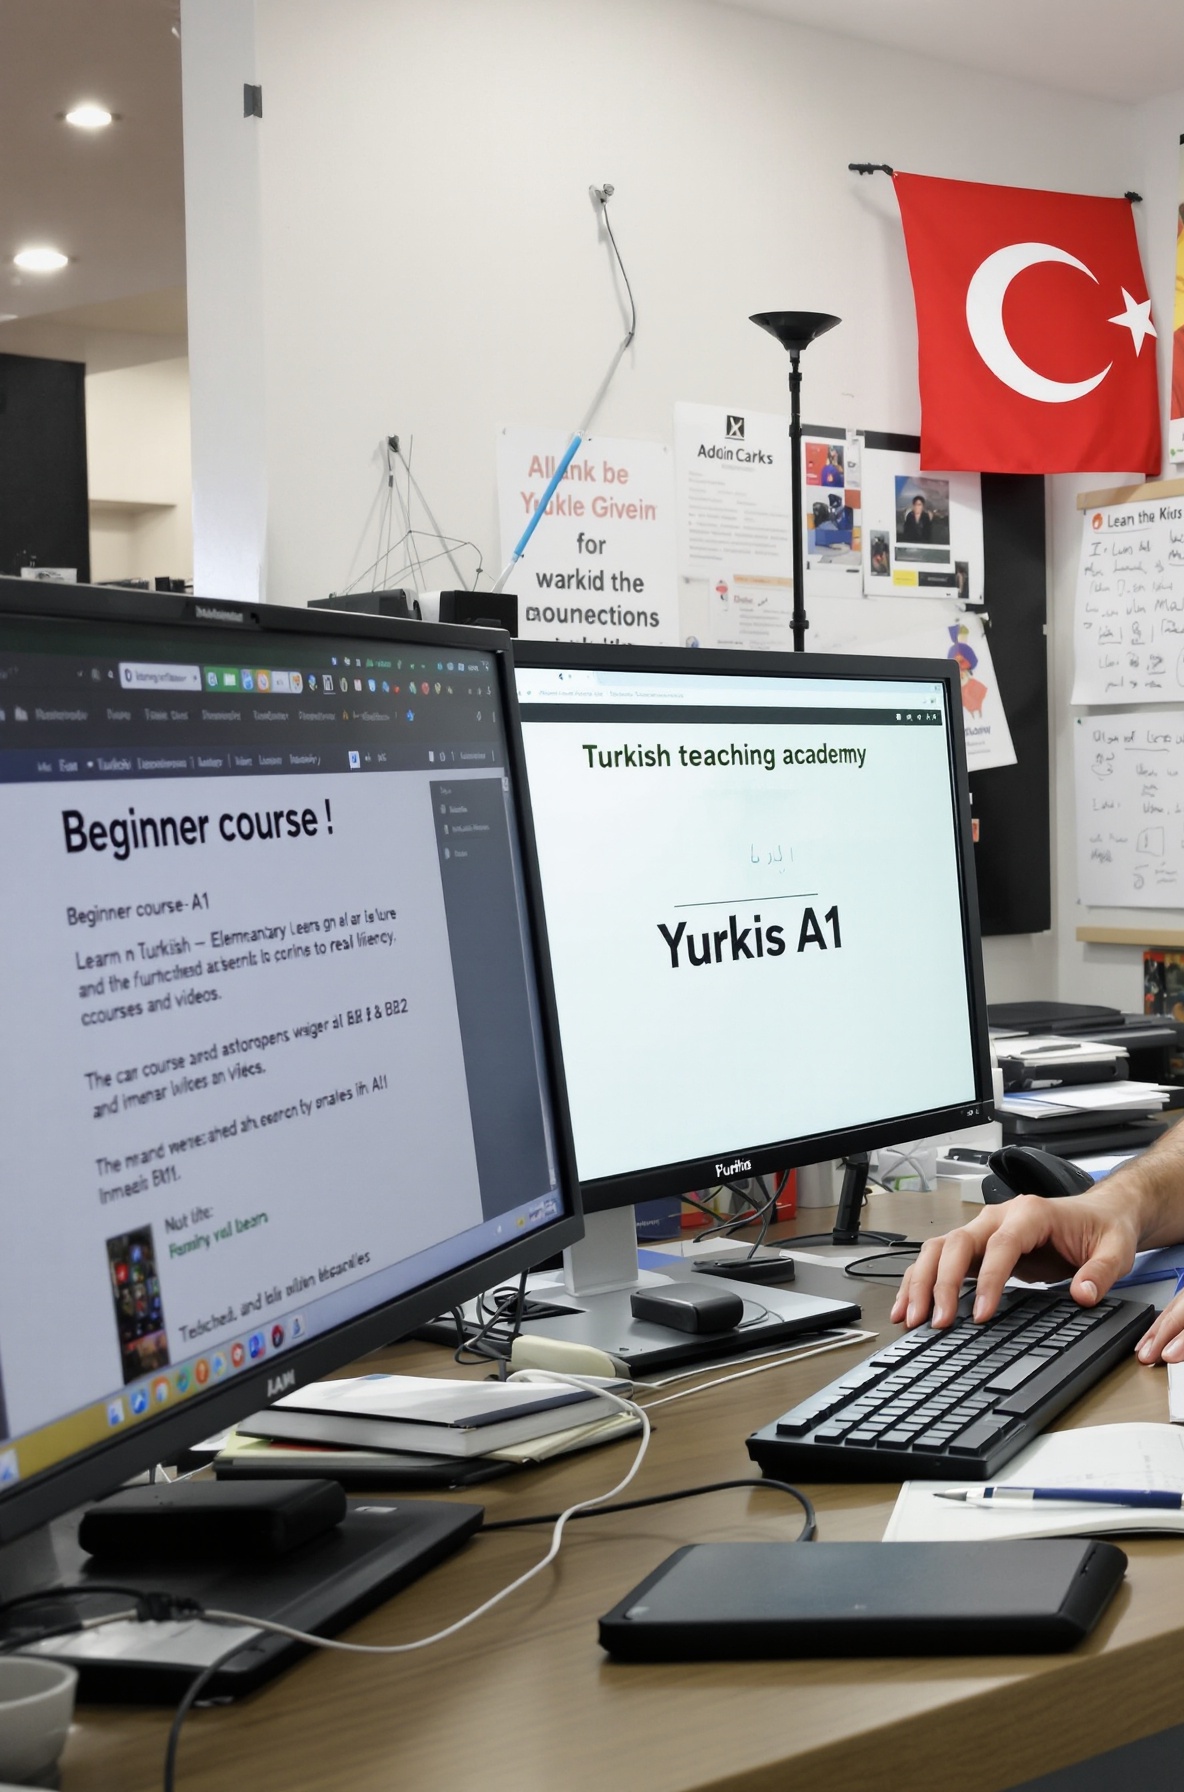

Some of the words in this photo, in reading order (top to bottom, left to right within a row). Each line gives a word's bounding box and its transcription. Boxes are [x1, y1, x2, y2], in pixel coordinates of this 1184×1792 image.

[736, 448, 773, 465] Carks
[603, 460, 629, 484] be
[591, 496, 657, 521] Givein
[1138, 510, 1155, 523] the
[577, 532, 606, 555] for
[536, 568, 604, 592] warkid
[611, 571, 644, 593] the
[582, 744, 671, 769] Turkish
[678, 743, 775, 770] teaching
[62, 805, 209, 860] Beginner
[219, 805, 319, 843] course
[67, 902, 131, 928] Beginner
[192, 892, 210, 911] A1
[657, 914, 785, 969] Yurkis
[797, 905, 843, 953] A1
[79, 976, 105, 999] and
[109, 970, 130, 992] the
[147, 993, 171, 1014] and
[84, 1071, 111, 1091] The
[142, 1056, 185, 1078] course
[95, 1157, 122, 1177] The
